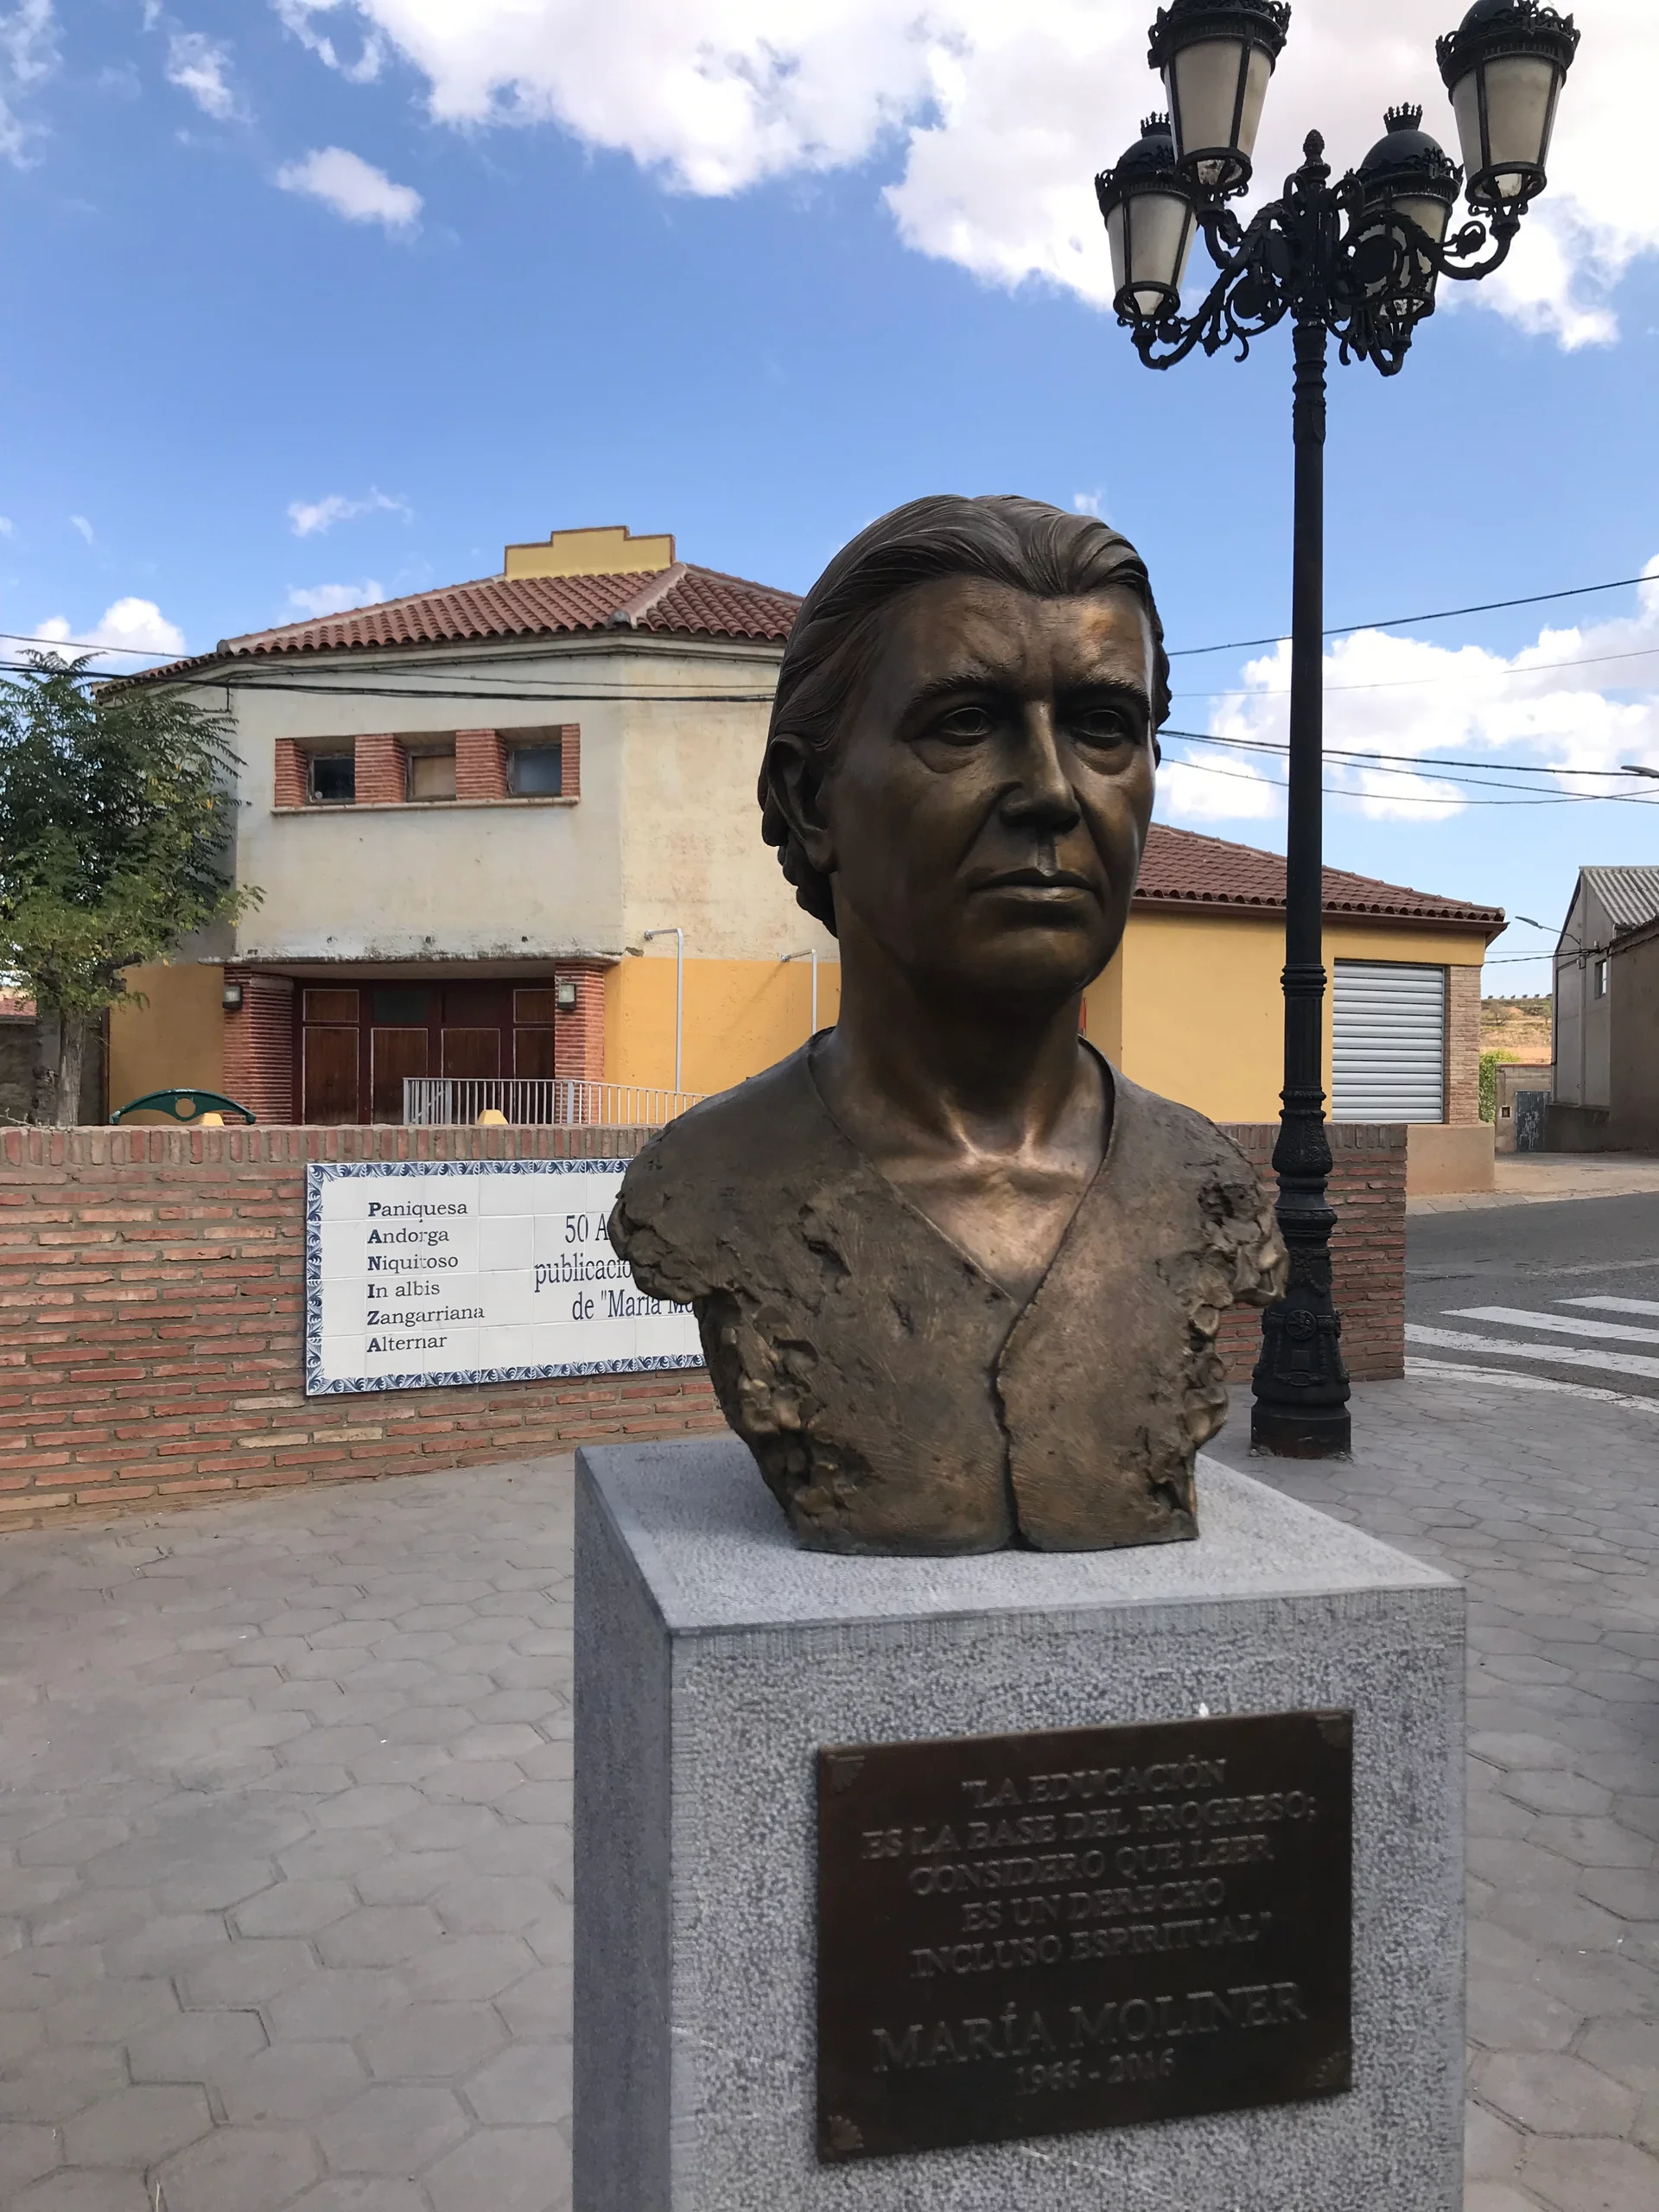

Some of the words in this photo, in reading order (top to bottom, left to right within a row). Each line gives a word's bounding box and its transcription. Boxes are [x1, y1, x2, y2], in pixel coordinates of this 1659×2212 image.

[367, 1200, 468, 1223] Paniquesa
[367, 1227, 449, 1246] Andorga
[564, 1214, 588, 1243] 50
[367, 1254, 459, 1274] Niquitoso
[367, 1283, 388, 1299] In
[395, 1281, 440, 1297] albis
[366, 1306, 486, 1327] Zangarriana
[571, 1291, 594, 1320] de
[366, 1336, 448, 1353] Alternar
[961, 1776, 1023, 1809] "LA
[1026, 1753, 1228, 1804] EDUCACIÓN
[861, 1827, 903, 1860] ES
[911, 1823, 962, 1855] LA
[967, 1814, 1058, 1851] BASE
[1064, 1807, 1131, 1841] DEL
[908, 1850, 1106, 1895] CONSIDERO
[1115, 1840, 1183, 1880] QUE
[1190, 1833, 1276, 1869] LEER
[961, 1899, 1002, 1933] ES
[1009, 1892, 1063, 1928] UN
[1067, 1877, 1226, 1922] DERECHO
[909, 1935, 1064, 1979] INCLUSO
[1069, 1910, 1274, 1962] ESPIRITUAL"
[871, 2000, 1058, 2073] MARÍA
[1068, 1980, 1309, 2050] MOLINER
